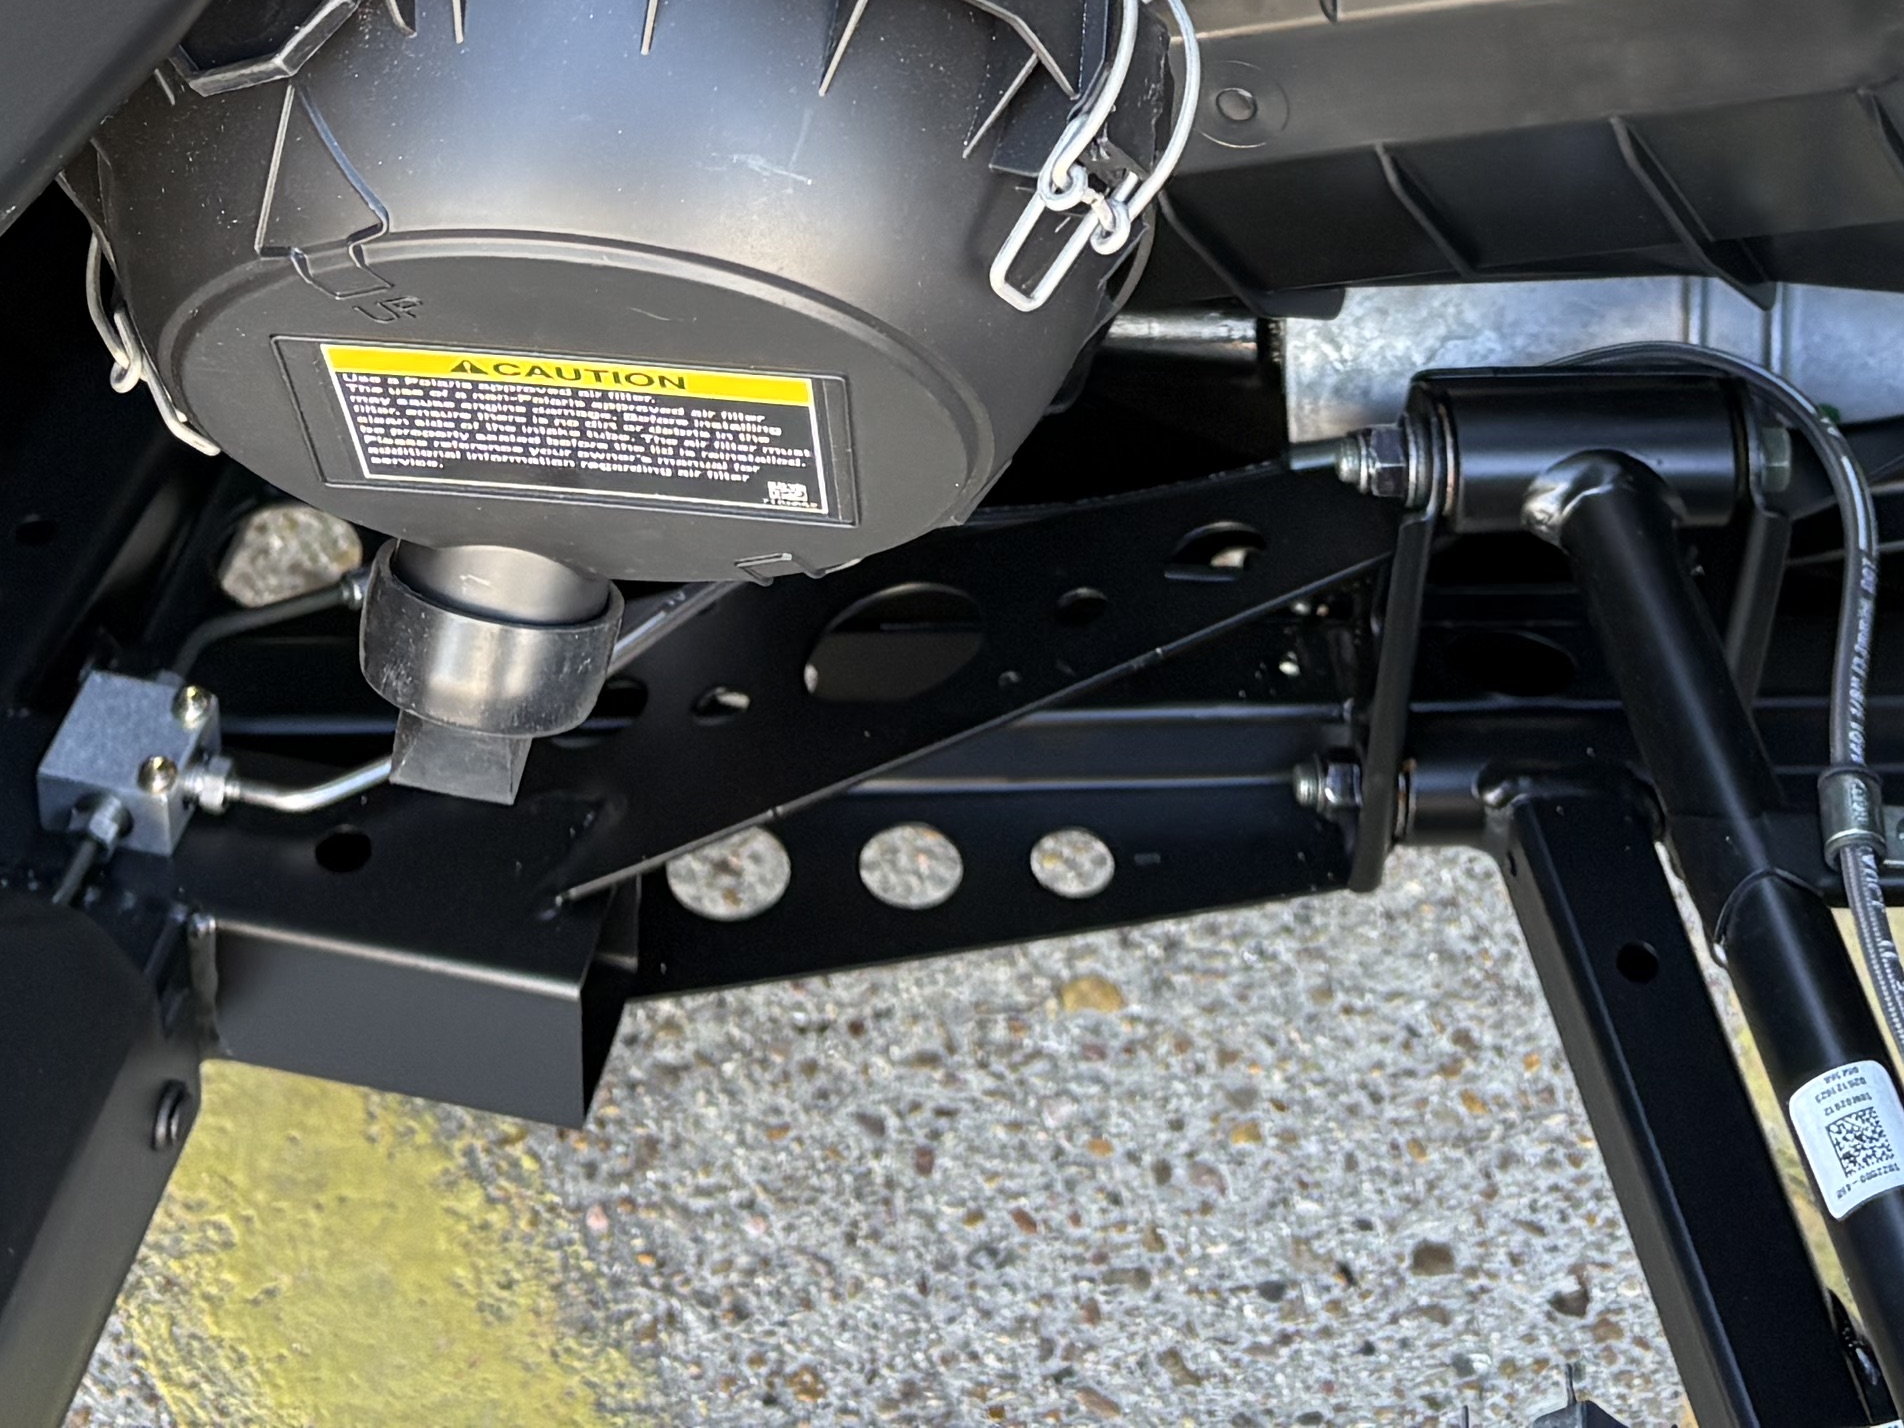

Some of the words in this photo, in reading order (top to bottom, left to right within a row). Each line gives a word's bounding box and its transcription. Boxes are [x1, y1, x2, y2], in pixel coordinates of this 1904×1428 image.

[343, 373, 381, 384] Use
[405, 376, 472, 390] Polaris
[478, 382, 572, 397] approved
[578, 386, 602, 399] air
[608, 391, 656, 404] filter.
[492, 361, 687, 390] CAUTION
[346, 383, 383, 394] The
[389, 387, 424, 396] use
[473, 392, 585, 408] non-Polaris
[591, 401, 684, 417] approved
[721, 411, 765, 423] filter
[350, 395, 390, 406] may
[396, 398, 455, 409] cause
[461, 401, 526, 414] engine
[532, 404, 617, 421] damage.
[623, 413, 690, 427] Before
[694, 419, 782, 436] installing
[357, 415, 409, 426] clean
[414, 418, 456, 429] side
[485, 423, 516, 433] the
[521, 425, 581, 437] intake
[586, 430, 636, 443] tube.
[640, 433, 678, 445] The
[713, 440, 757, 453] filter
[762, 445, 811, 458] must
[405, 409, 472, 420] ensure
[477, 411, 527, 424] there
[585, 420, 618, 431] dirt
[648, 425, 711, 439] debris
[738, 432, 770, 444] the
[363, 435, 428, 447] Please
[433, 439, 524, 453] reference
[529, 446, 573, 457] your
[577, 449, 652, 464] owner's
[657, 456, 728, 470] manual
[734, 460, 760, 472] for
[367, 446, 462, 460] additional
[466, 451, 577, 468] information
[580, 460, 672, 477] regarding
[706, 469, 750, 482] filter
[371, 455, 444, 469] service.
[390, 427, 469, 441] properly
[475, 432, 541, 445] sealed
[546, 436, 608, 450] before
[614, 442, 646, 453] the
[701, 449, 807, 467] reinstalled.
